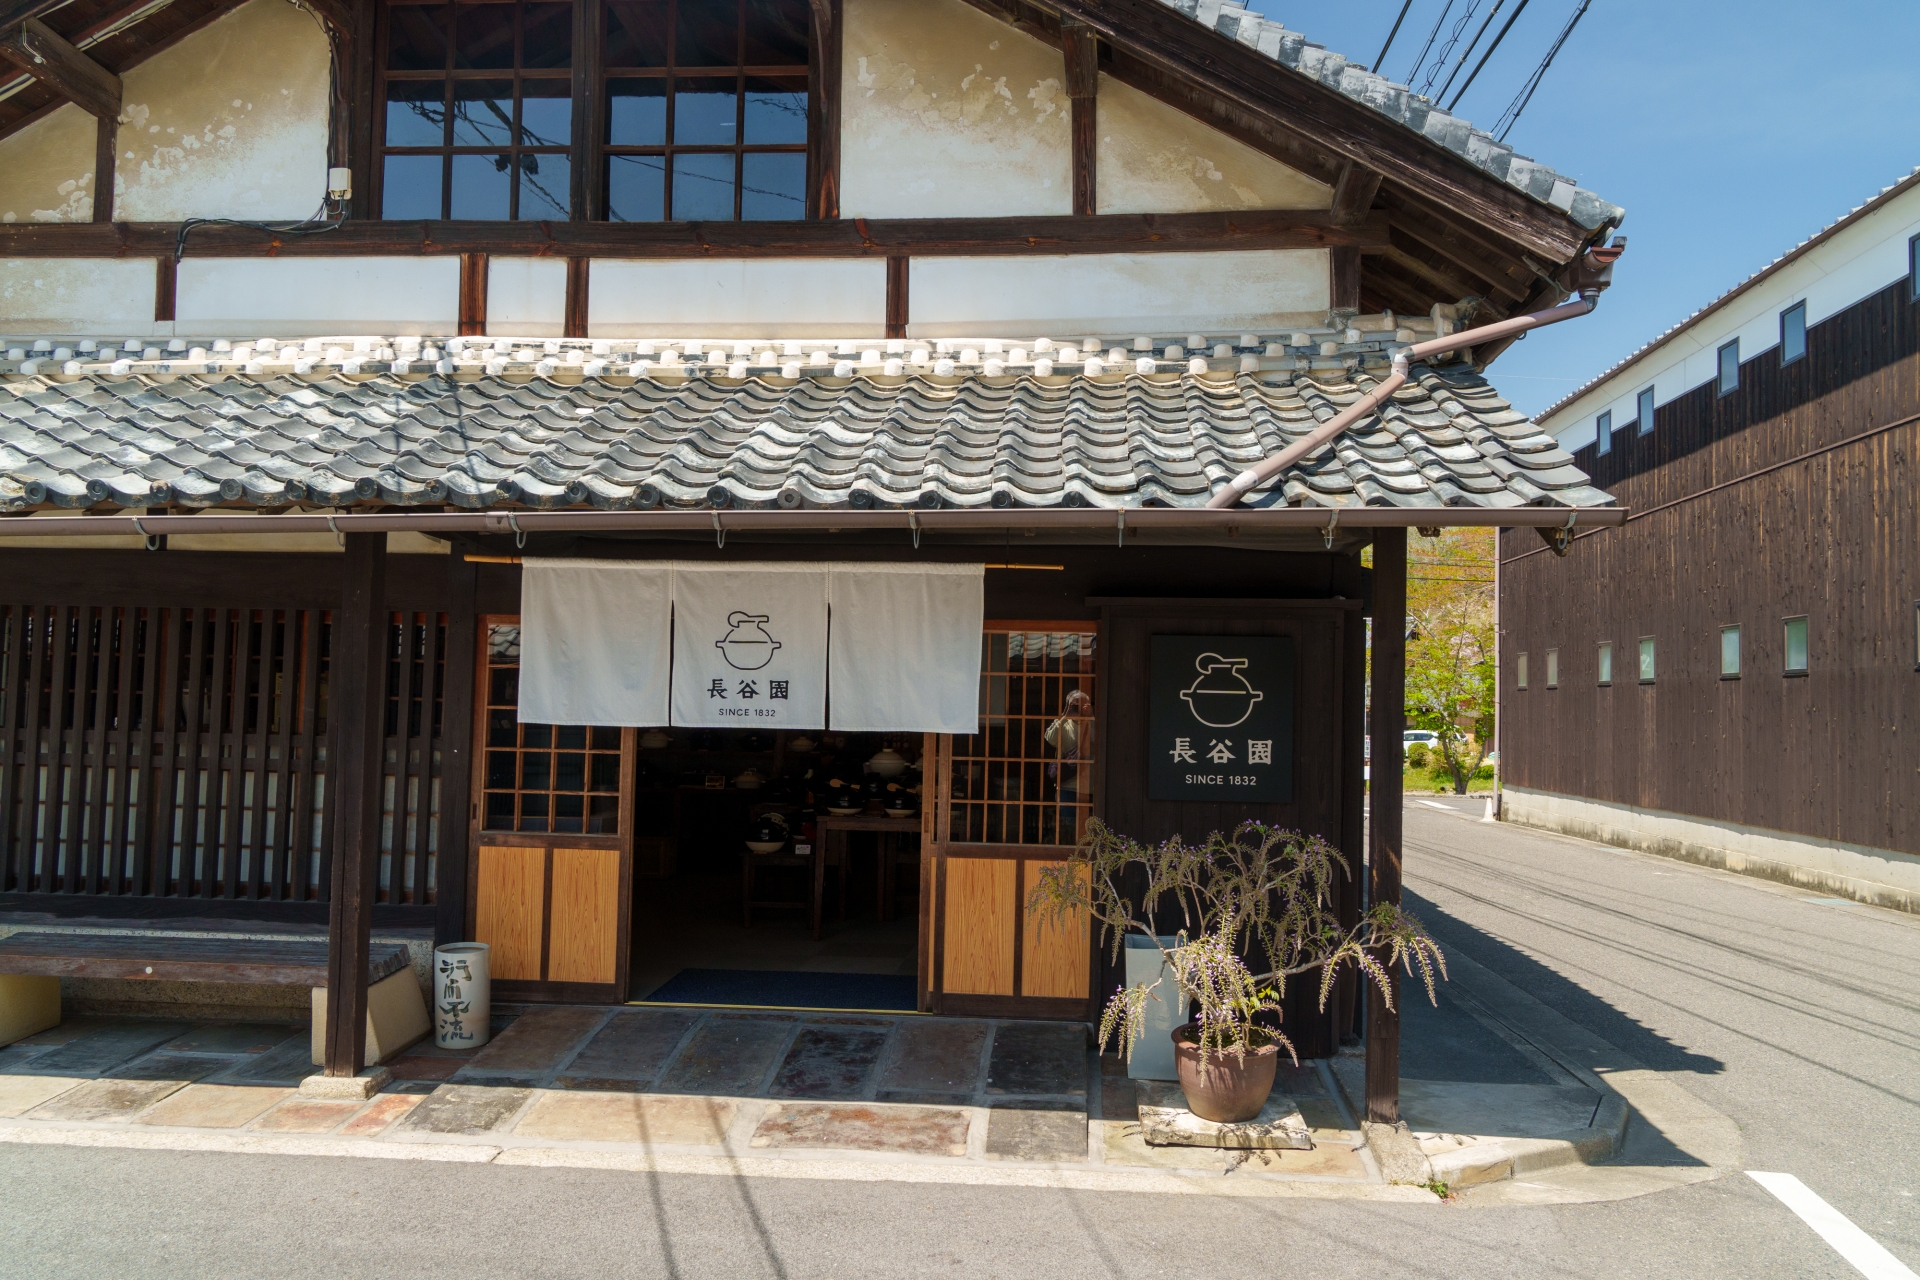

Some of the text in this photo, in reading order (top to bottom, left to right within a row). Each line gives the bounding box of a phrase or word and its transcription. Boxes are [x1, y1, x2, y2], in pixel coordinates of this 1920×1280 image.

[707, 678, 789, 700] 長谷園
[718, 708, 776, 718] SINCE 1832
[1169, 737, 1273, 765] 長谷園
[1185, 774, 1257, 786] SINCE 1832
